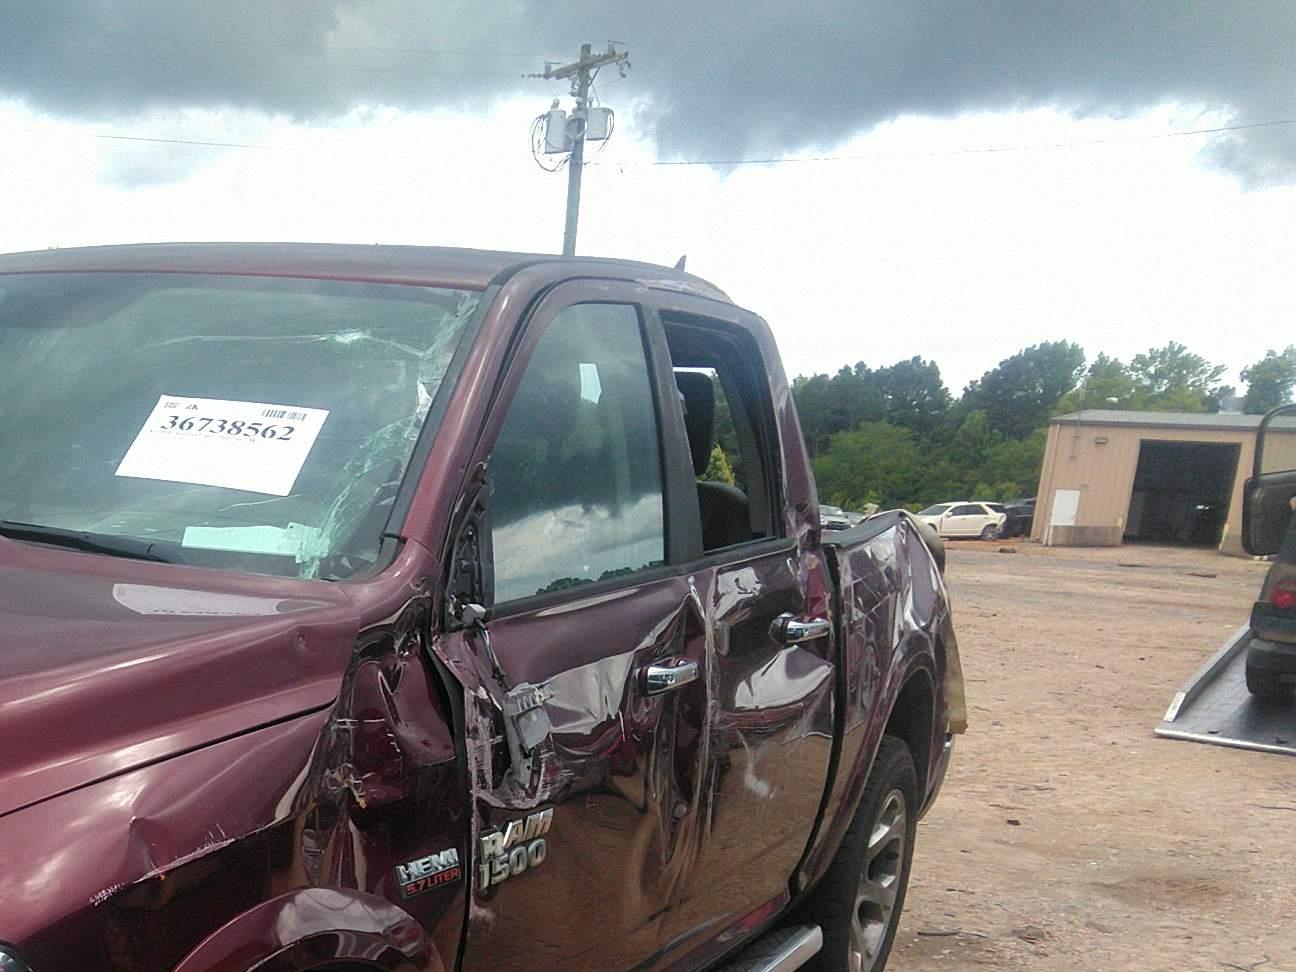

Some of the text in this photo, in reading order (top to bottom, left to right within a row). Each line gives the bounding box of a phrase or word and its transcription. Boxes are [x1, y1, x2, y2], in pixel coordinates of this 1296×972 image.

[160, 415, 295, 441] 36738562
[479, 808, 554, 862] RAM
[396, 848, 459, 883] HEMI
[427, 867, 461, 887] LITER
[479, 838, 547, 890] 1500
